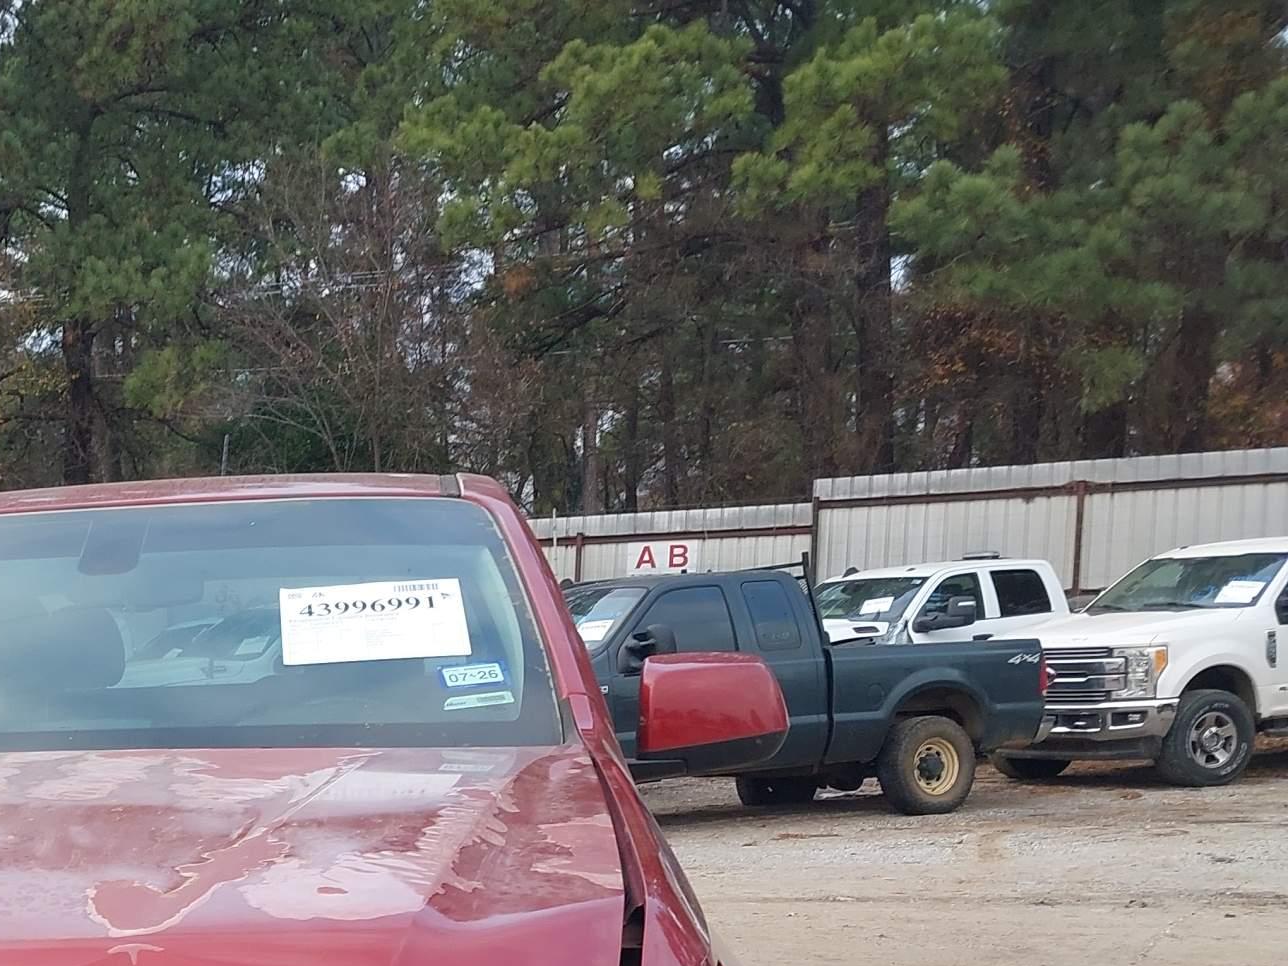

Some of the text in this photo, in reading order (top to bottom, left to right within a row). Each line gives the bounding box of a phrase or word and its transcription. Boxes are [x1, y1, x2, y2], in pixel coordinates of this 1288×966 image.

[635, 544, 689, 569] A B
[299, 595, 435, 617] 43996991
